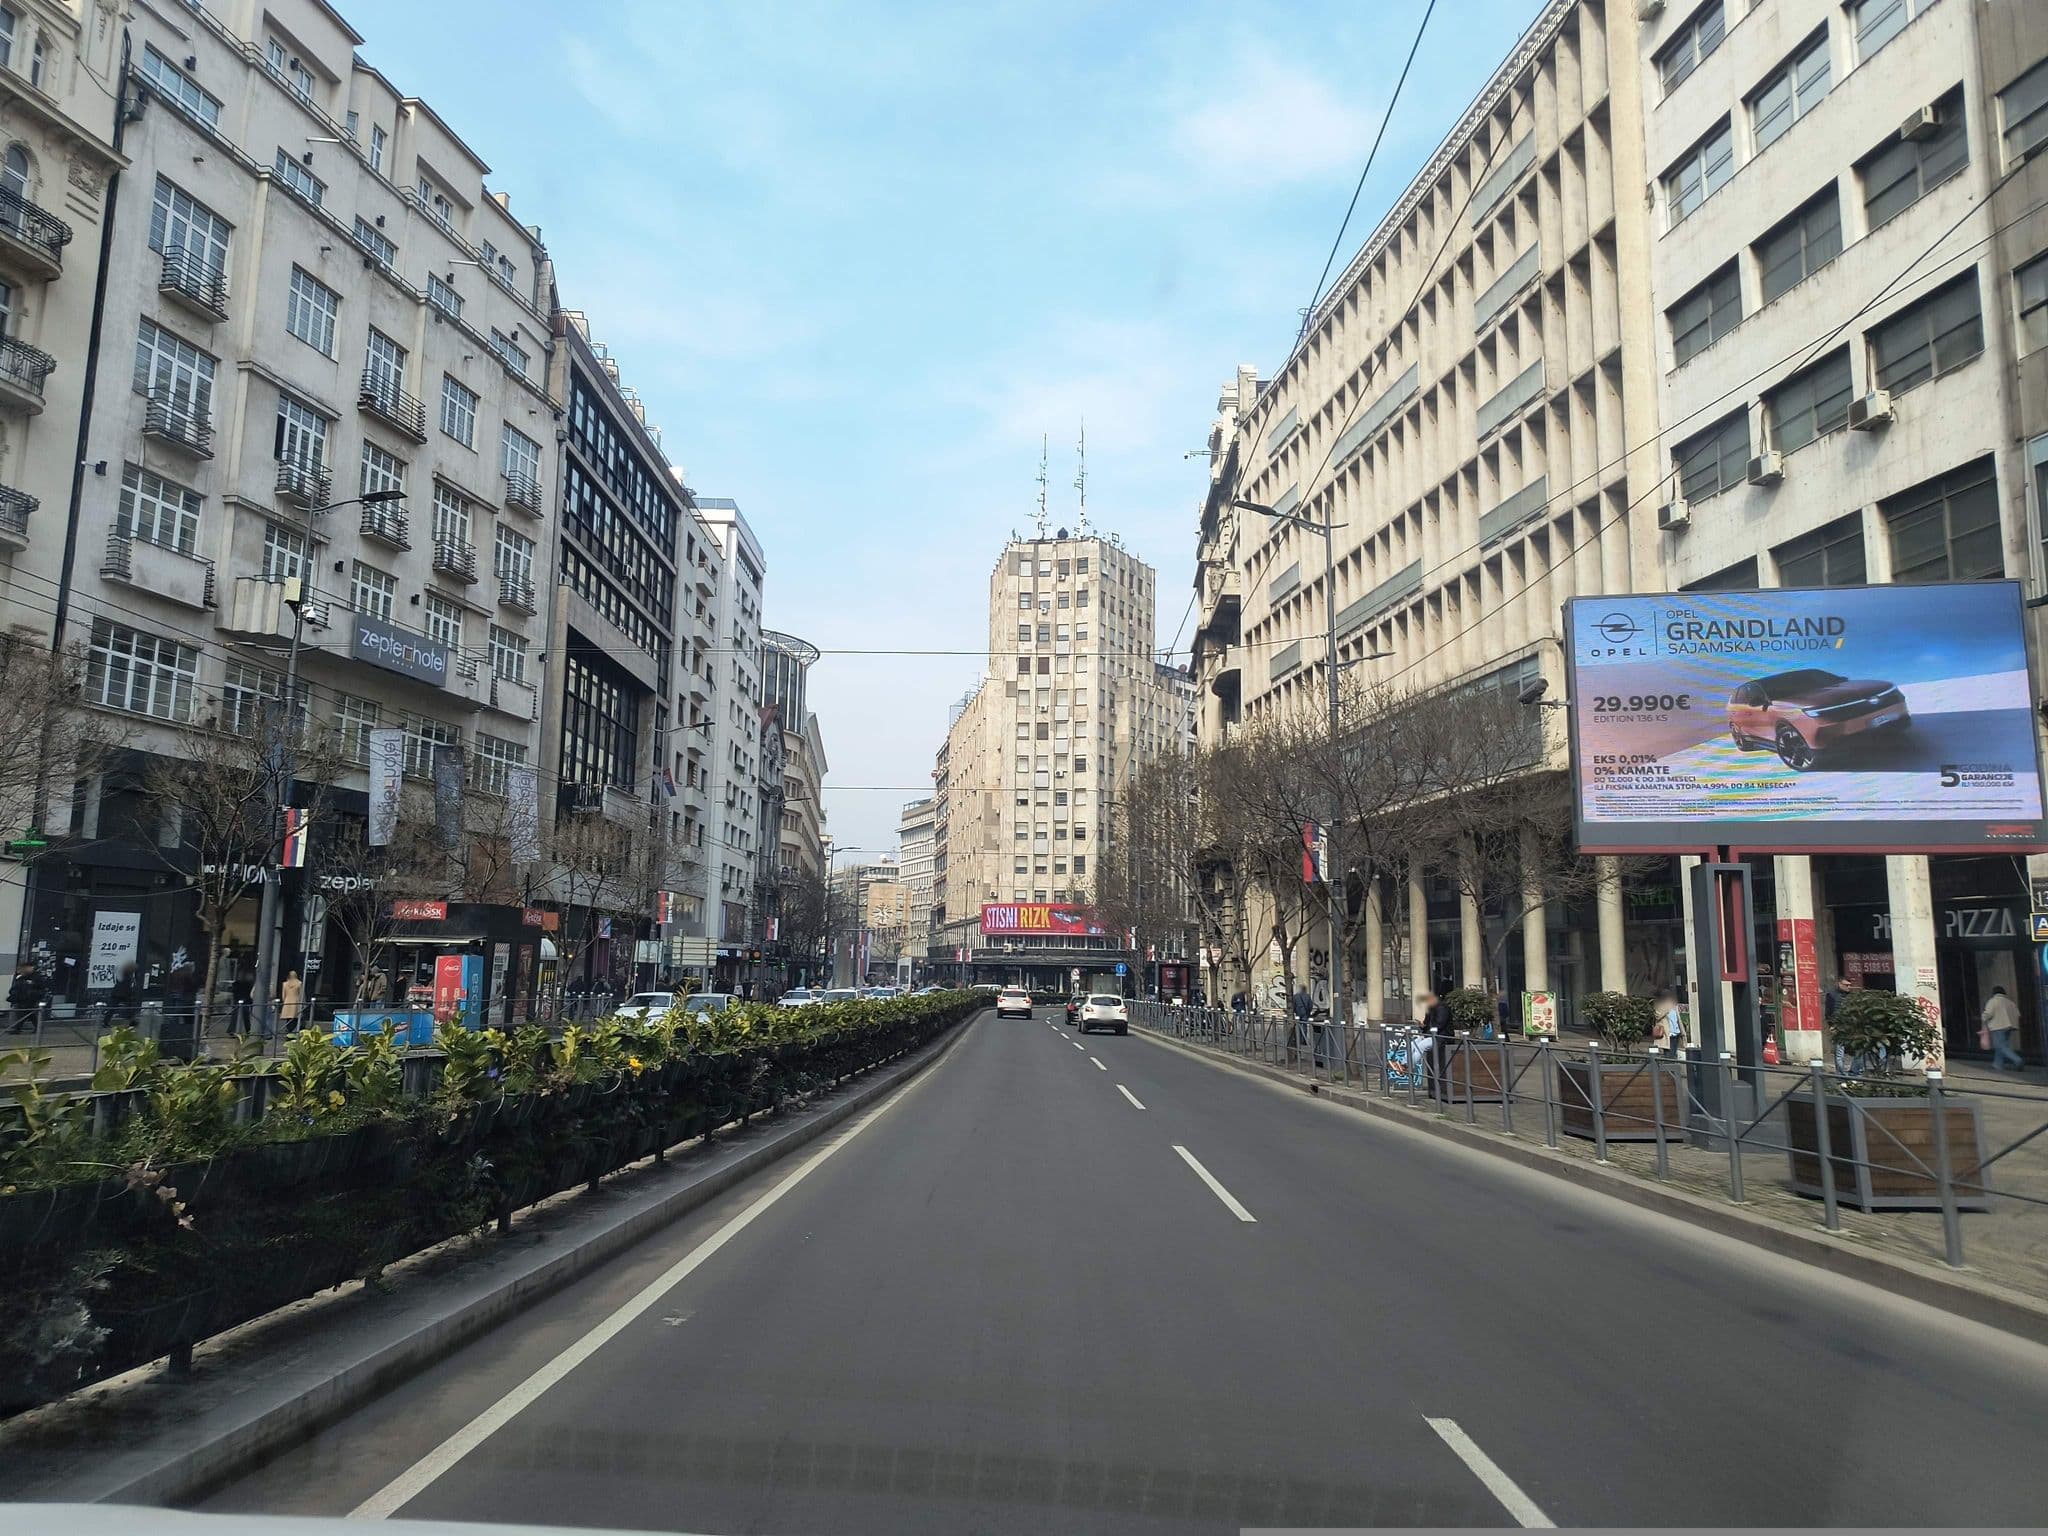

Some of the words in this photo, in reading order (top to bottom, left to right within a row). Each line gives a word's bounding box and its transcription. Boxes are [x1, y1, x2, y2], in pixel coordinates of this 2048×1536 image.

[1665, 610, 1698, 619] OPEL
[1666, 616, 1845, 641] GRANDLAND
[1668, 640, 1755, 655] SAJAMSKA
[1760, 638, 1831, 652] PONUDA
[1591, 648, 1647, 657] OPEL
[1593, 694, 1691, 712] 29.990€
[1594, 715, 1634, 723] EDITION
[1637, 714, 1653, 722] 136
[1655, 714, 1668, 722] KS
[1593, 755, 1616, 764] EKS
[1619, 754, 1657, 765] 0,01%
[1594, 766, 1615, 776] 0%
[1618, 766, 1670, 775] KAMATE
[1941, 765, 1960, 787] 5
[98, 922, 124, 932] Izdaje
[1945, 908, 2017, 937] PIZZA
